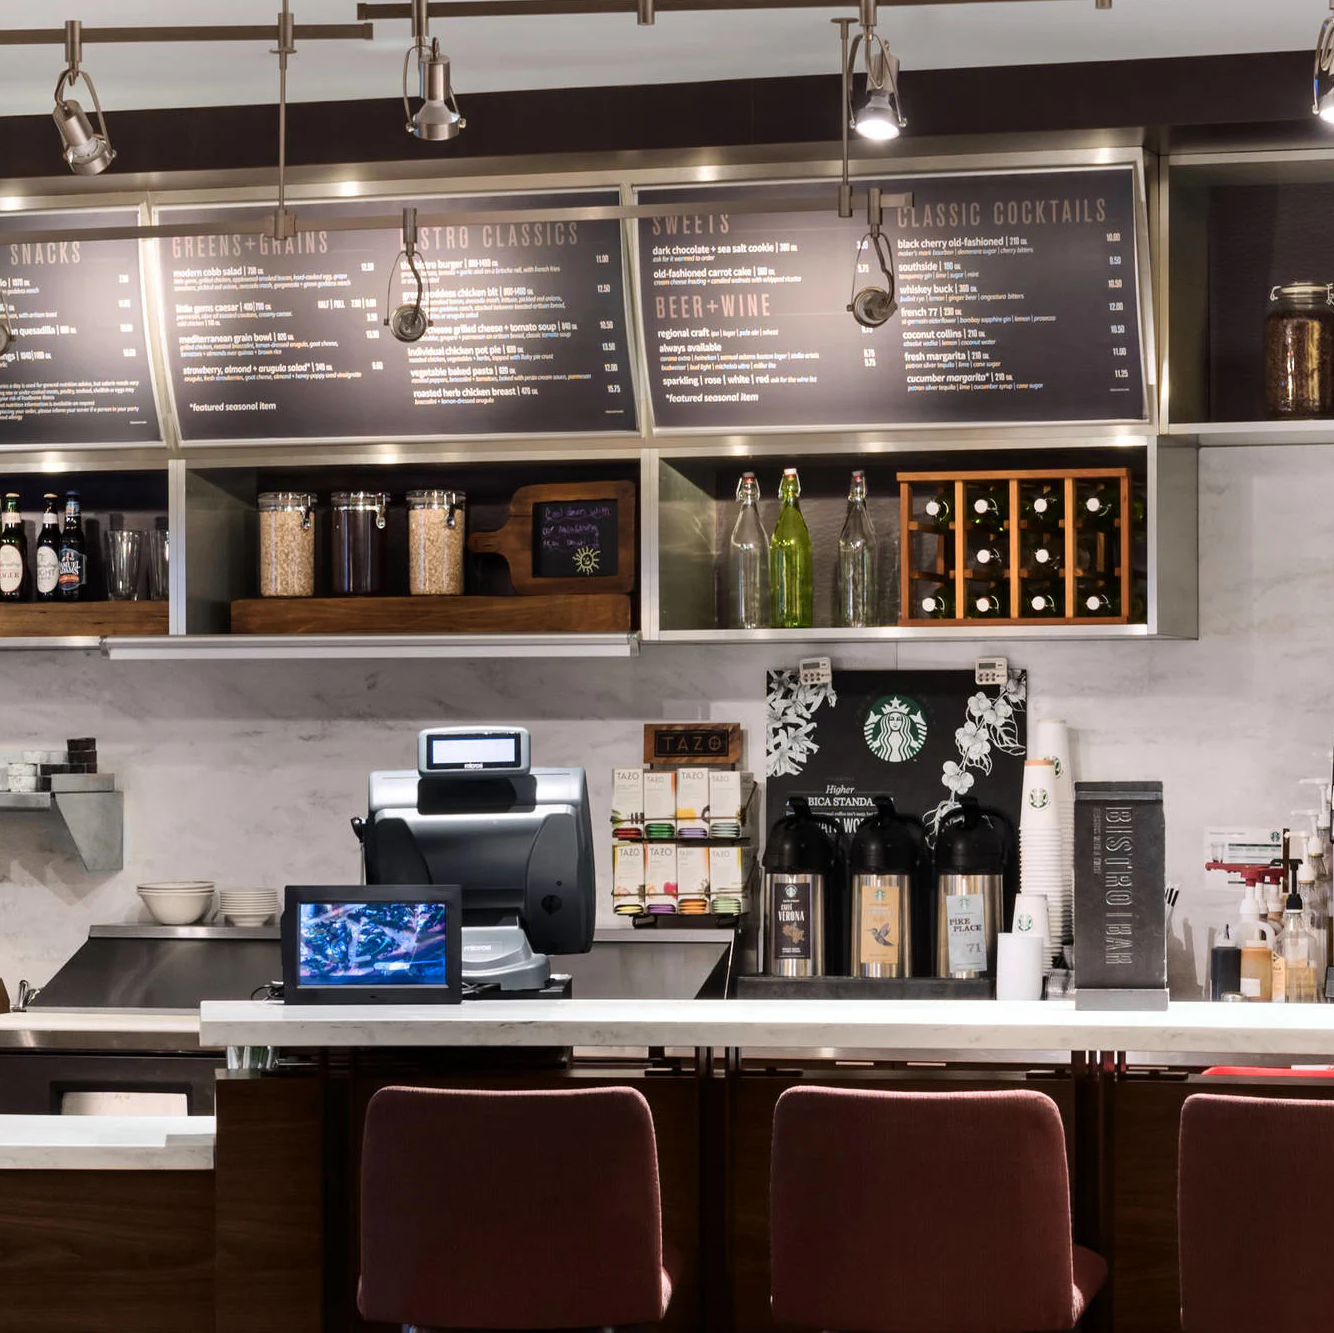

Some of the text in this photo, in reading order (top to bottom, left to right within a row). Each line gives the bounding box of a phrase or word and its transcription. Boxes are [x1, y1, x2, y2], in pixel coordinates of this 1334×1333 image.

[897, 198, 1107, 228] CLASSIC COCKTAILS
[400, 222, 578, 251] STRO CLASSICS
[652, 243, 774, 255] dark chocolate sea salt cookie
[897, 237, 1004, 250] black cherry old-fashioned
[10, 241, 82, 266] SNACKS
[437, 260, 463, 270] burger
[898, 262, 937, 272] southside
[173, 266, 242, 277] modern cobb salad
[653, 267, 751, 279] old-fashioned carrot cake
[457, 287, 486, 297] chicken
[900, 284, 953, 296] whiskey buck
[194, 305, 214, 315] gems
[214, 304, 239, 312] caesar
[901, 307, 938, 317] french 77
[19, 325, 55, 337] quesadilla
[453, 323, 557, 335] grilled cheese tomato soup
[657, 328, 709, 340] regional craft
[902, 329, 962, 340] coconut collins
[179, 332, 272, 344] mediterranean grain bowl
[408, 345, 501, 357] individual chicken pot pie
[659, 342, 722, 355] always available
[904, 351, 966, 363] fresh margarita
[182, 365, 224, 376] strawberry,
[224, 364, 251, 374] almond
[258, 364, 287, 375] arugula
[410, 367, 494, 379] vegetable baked pasta
[662, 374, 769, 387] sparkling rose white red
[907, 374, 945, 384] cucumber
[413, 387, 516, 398] roasted herb chicken breast
[704, 393, 740, 403] seasonal
[740, 392, 759, 402] item
[225, 402, 258, 411] seasonal
[259, 401, 277, 410] item
[662, 735, 722, 751] TAZO
[617, 771, 640, 781] TAZO
[681, 771, 705, 781] TAZO
[825, 784, 855, 795] Higher
[833, 797, 876, 806] STANDA
[620, 848, 640, 857] TAZO
[650, 847, 673, 857] TAZO
[1105, 806, 1133, 965] BISTRO BAR
[778, 910, 805, 922] VERONA
[949, 918, 971, 926] PIKE
[953, 924, 982, 932] PLACE
[966, 943, 982, 953] 71
